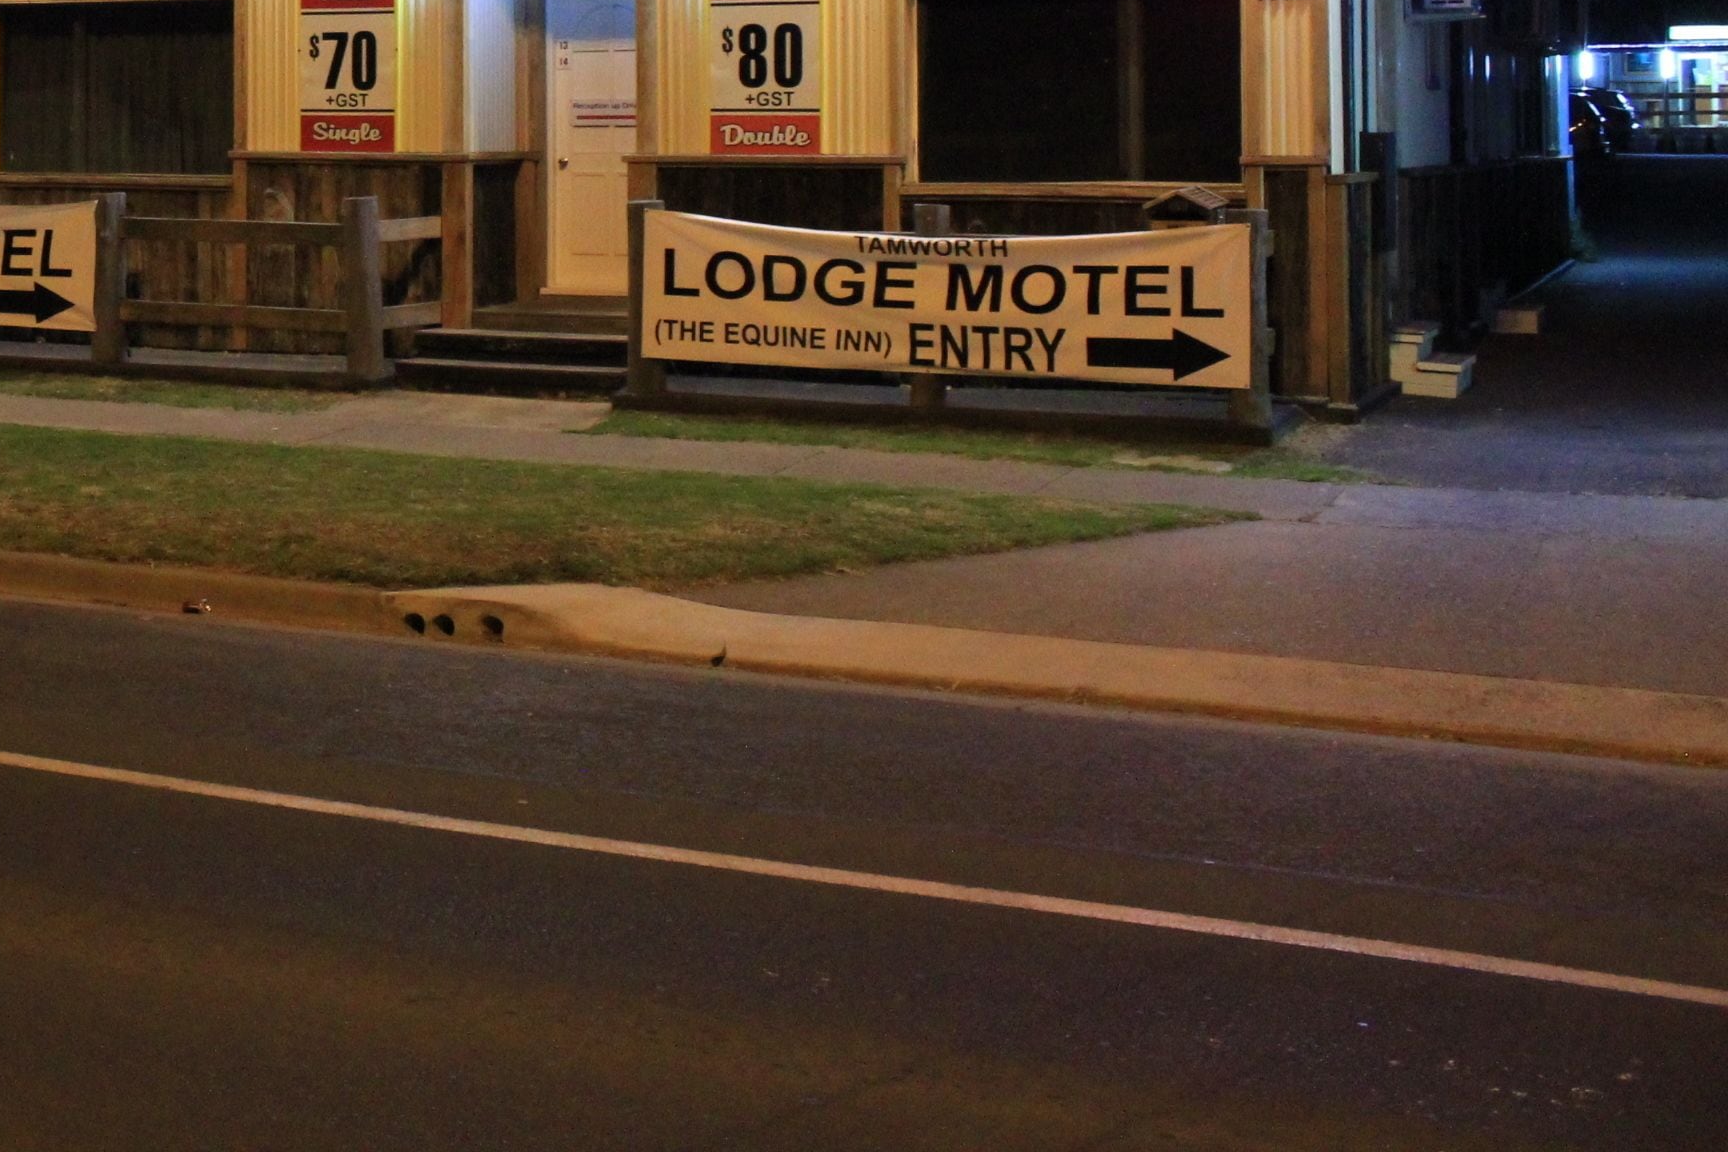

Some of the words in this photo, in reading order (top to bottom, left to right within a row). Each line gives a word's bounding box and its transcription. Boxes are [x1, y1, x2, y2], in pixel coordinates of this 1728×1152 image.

[309, 31, 377, 90] $70
[722, 23, 802, 88] $80
[326, 93, 369, 108] +GST
[745, 91, 795, 106] +GST
[313, 121, 382, 144] Single
[720, 124, 811, 146] Double
[853, 235, 1009, 258] TAMWORTH
[664, 248, 917, 310] LODGE
[946, 263, 1225, 319] MOTEL
[654, 319, 714, 344] (THE
[724, 322, 826, 351] EQUINE
[835, 328, 892, 358] INN)
[909, 323, 1066, 373] ENTRY
